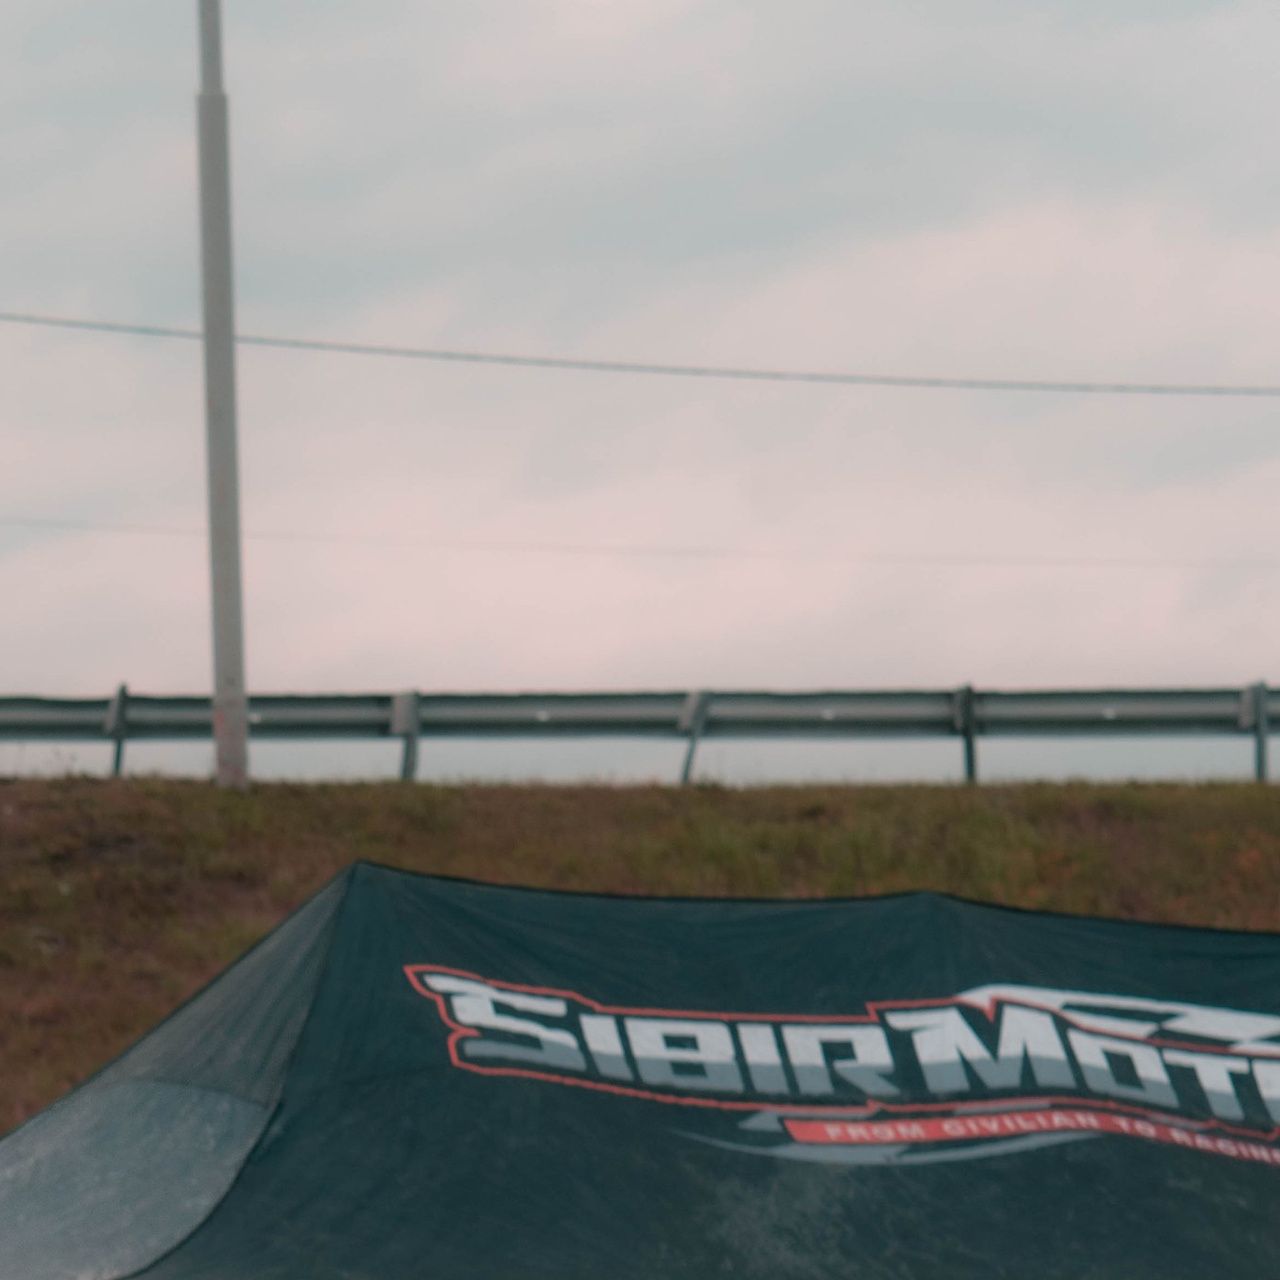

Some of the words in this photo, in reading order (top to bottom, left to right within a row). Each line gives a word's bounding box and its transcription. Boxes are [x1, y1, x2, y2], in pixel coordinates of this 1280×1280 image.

[424, 975, 1280, 1123] SIBIRMOT
[825, 1121, 926, 1142] FROM
[942, 1109, 1101, 1139] CIVILIAN
[1117, 1119, 1157, 1140] TO
